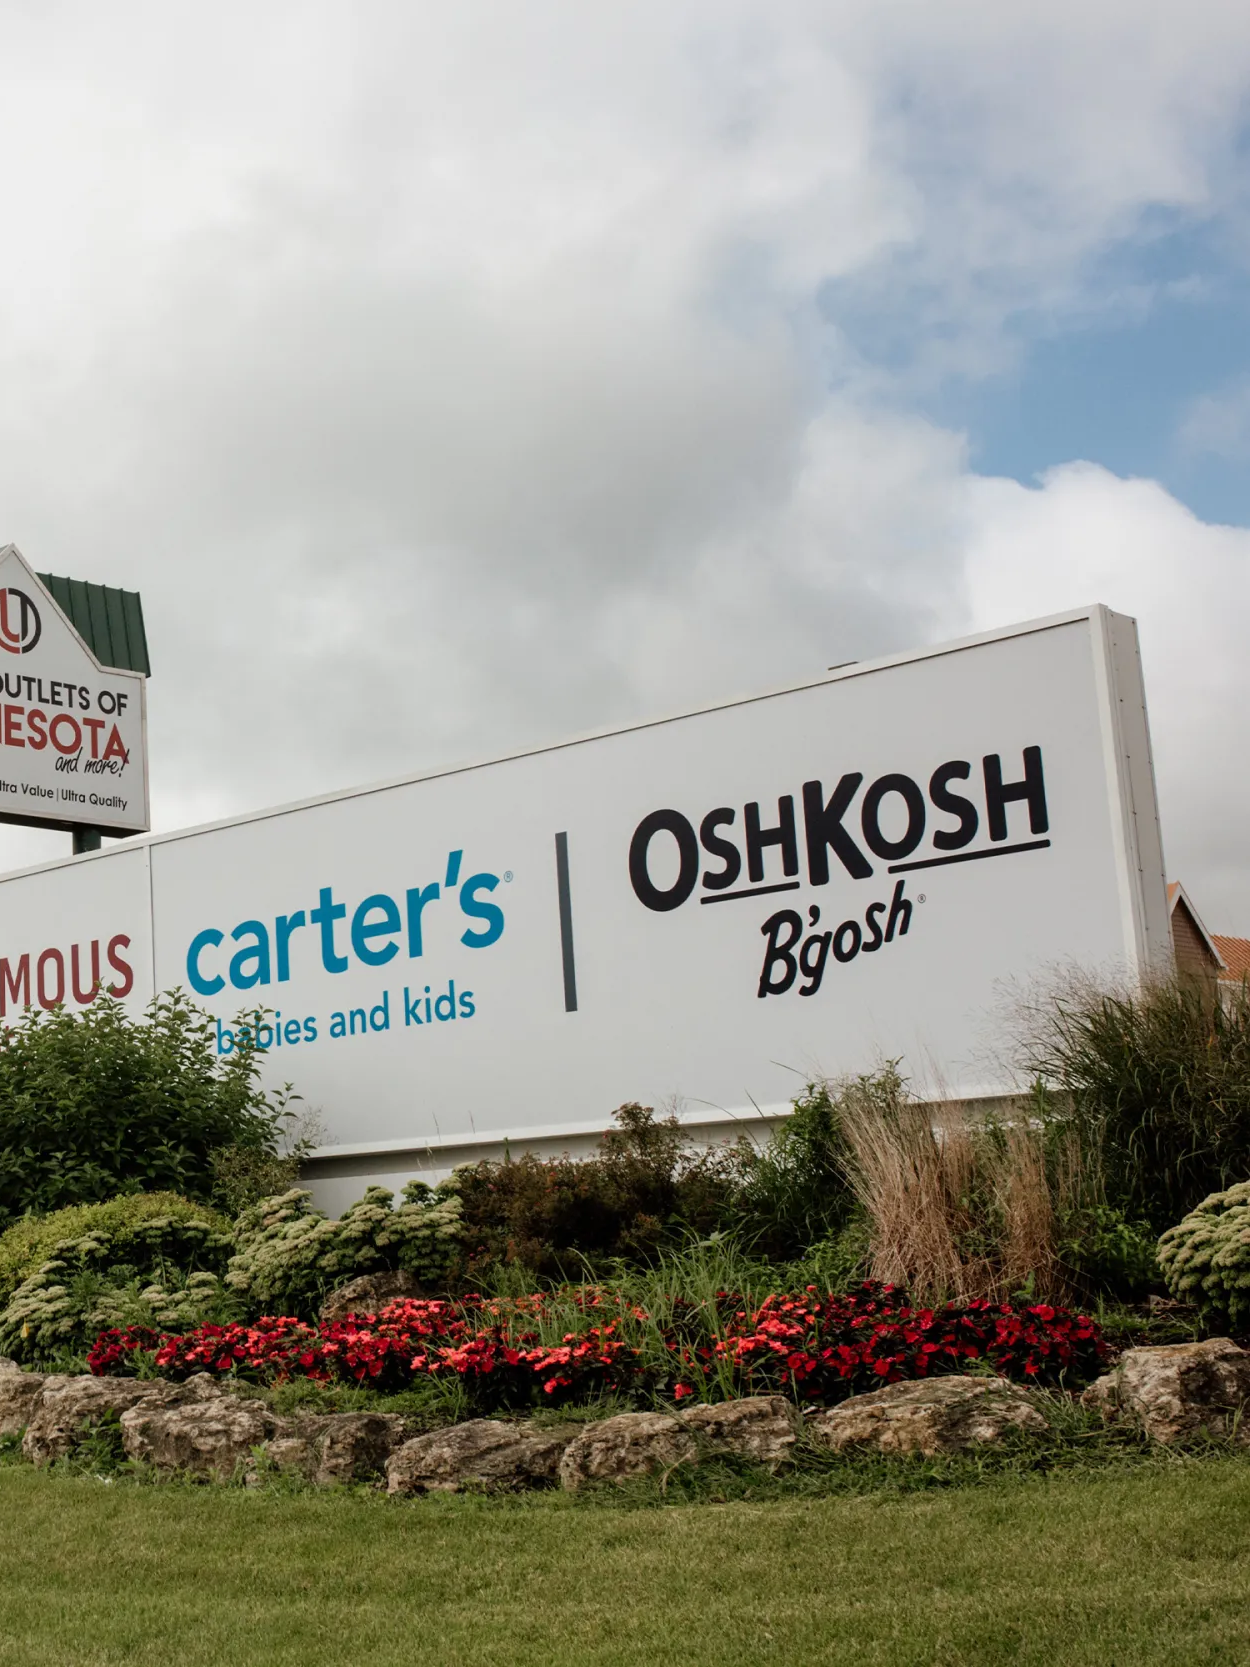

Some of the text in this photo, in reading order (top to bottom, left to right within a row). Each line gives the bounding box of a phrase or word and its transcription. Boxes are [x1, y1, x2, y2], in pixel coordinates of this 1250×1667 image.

[97, 690, 128, 717] OF
[21, 783, 54, 798] Value
[61, 788, 86, 803] Ultra
[89, 793, 128, 811] Quality
[55, 746, 129, 778] and more!
[629, 745, 1049, 912] OSHKOSH
[186, 849, 505, 996] carter's
[757, 879, 913, 998] B'gosh
[217, 979, 476, 1055] babies and kids
